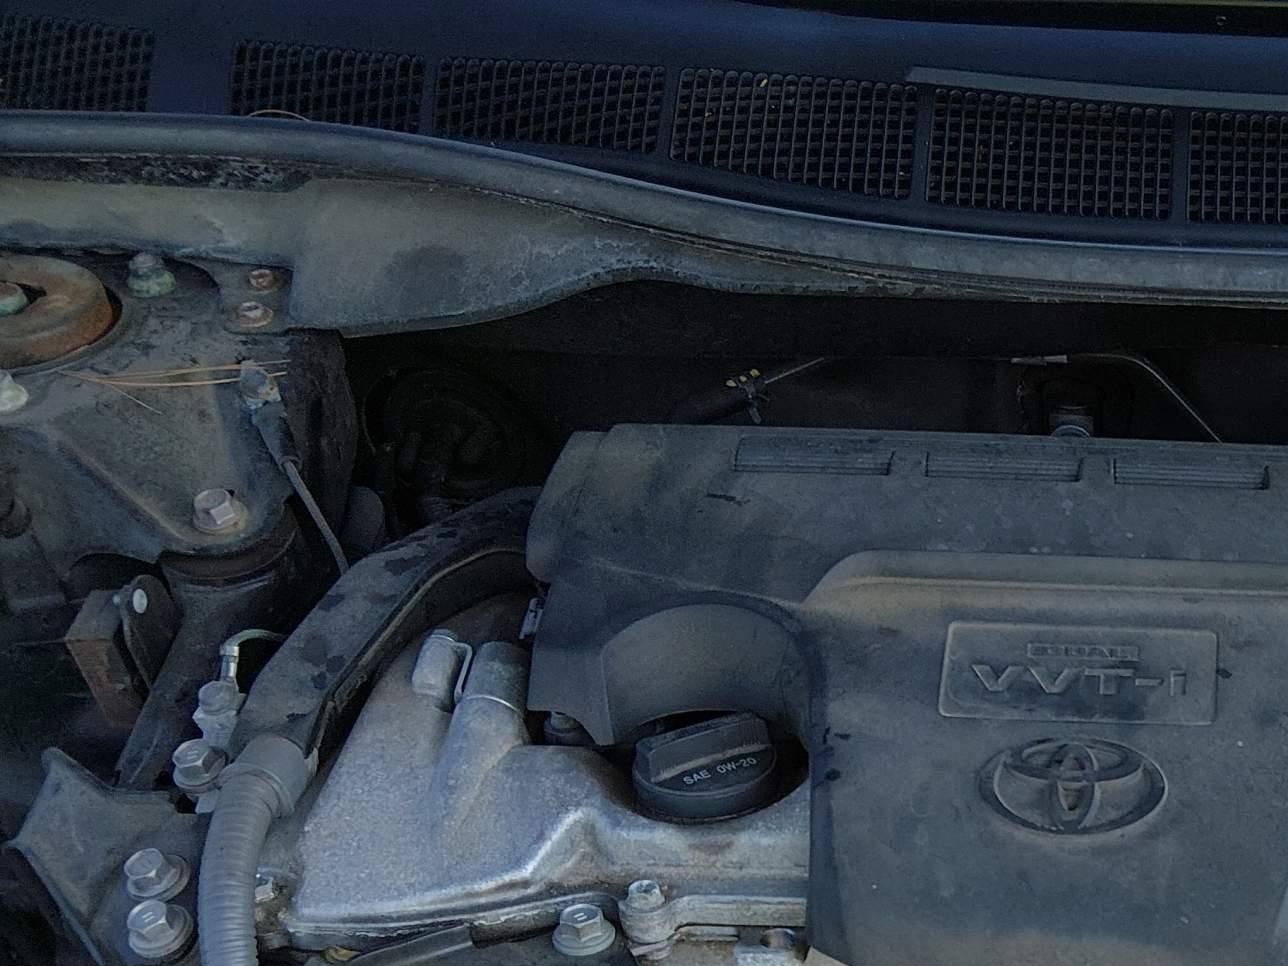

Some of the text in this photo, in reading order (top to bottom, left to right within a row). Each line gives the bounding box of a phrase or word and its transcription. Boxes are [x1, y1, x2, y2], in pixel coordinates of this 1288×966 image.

[971, 663, 1187, 696] VVT-i
[682, 757, 757, 785] SAE 0W-20
